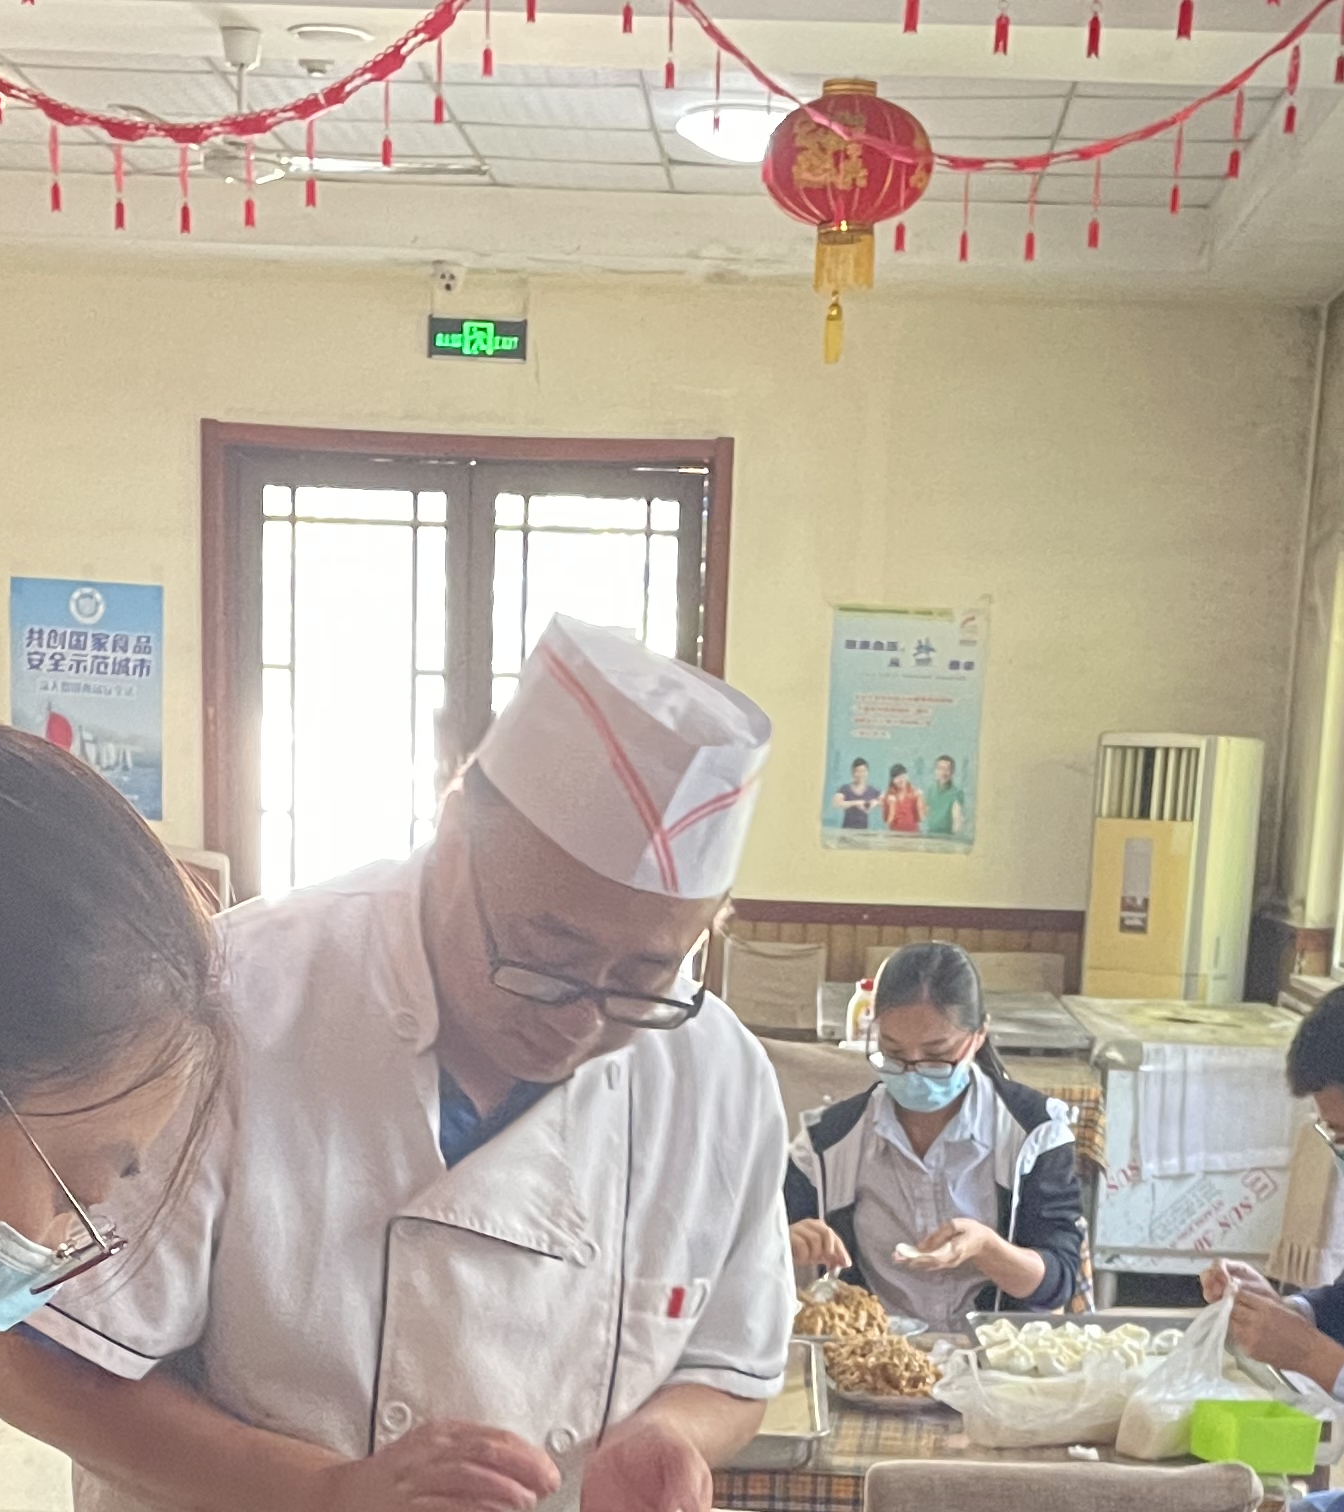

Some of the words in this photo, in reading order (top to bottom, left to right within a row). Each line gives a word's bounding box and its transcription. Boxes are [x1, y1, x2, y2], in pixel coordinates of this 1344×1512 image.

[25, 627, 152, 655] 共创国家食品
[27, 651, 152, 678] 安全示范城市
